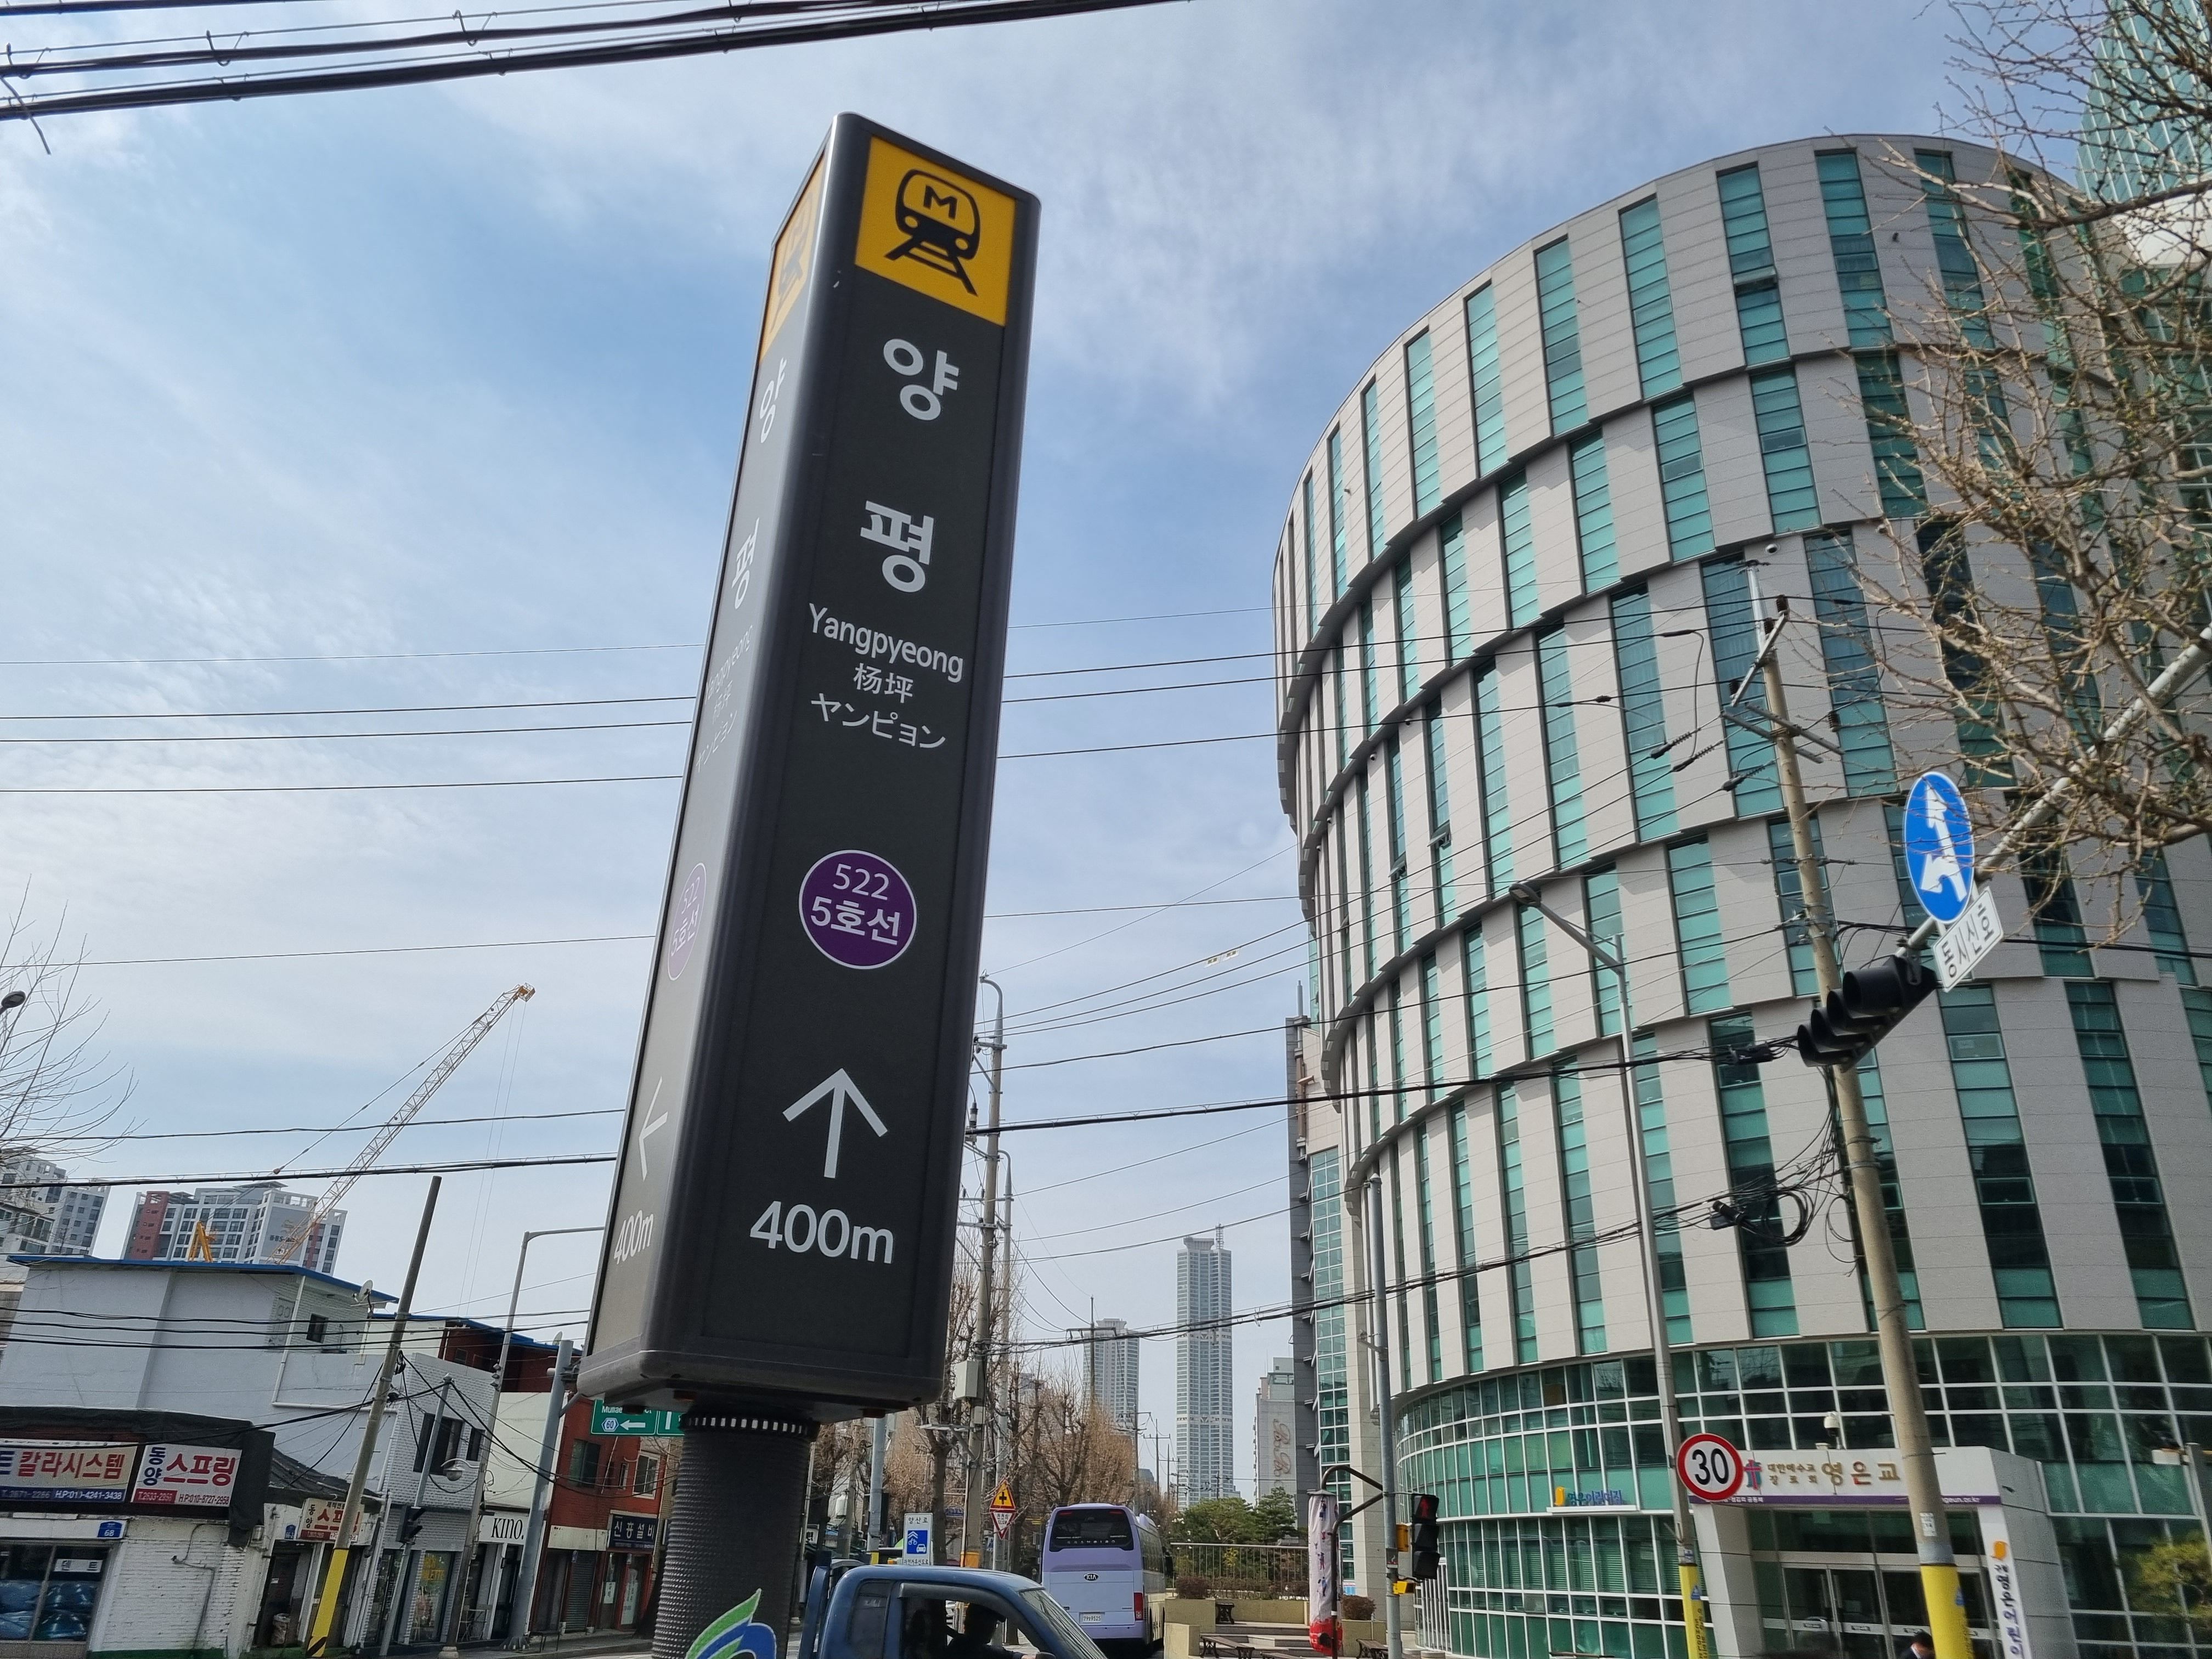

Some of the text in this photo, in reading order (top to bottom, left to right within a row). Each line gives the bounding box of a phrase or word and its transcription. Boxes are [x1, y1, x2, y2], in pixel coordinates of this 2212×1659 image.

[809, 602, 963, 683] Yangpyeong
[853, 662, 914, 703] 杨坪
[811, 693, 946, 748] ヤンピョン
[681, 876, 700, 915] 522
[833, 863, 889, 900] 522
[671, 903, 699, 957] 5호선
[810, 895, 900, 946] 5호선
[1942, 902, 1994, 978] 동시신호
[613, 1210, 654, 1265] 400m
[749, 1200, 894, 1264] 400m
[606, 1420, 614, 1429] 60
[18, 1451, 126, 1480] 칼라시스템
[144, 1447, 236, 1487] 동양 스프링
[1692, 1448, 1729, 1486] 30
[1767, 1463, 1816, 1474] 대한예수교
[1769, 1475, 1818, 1486] 장로회
[314, 1509, 360, 1533] 스프
[614, 1521, 655, 1540] 신흥설비
